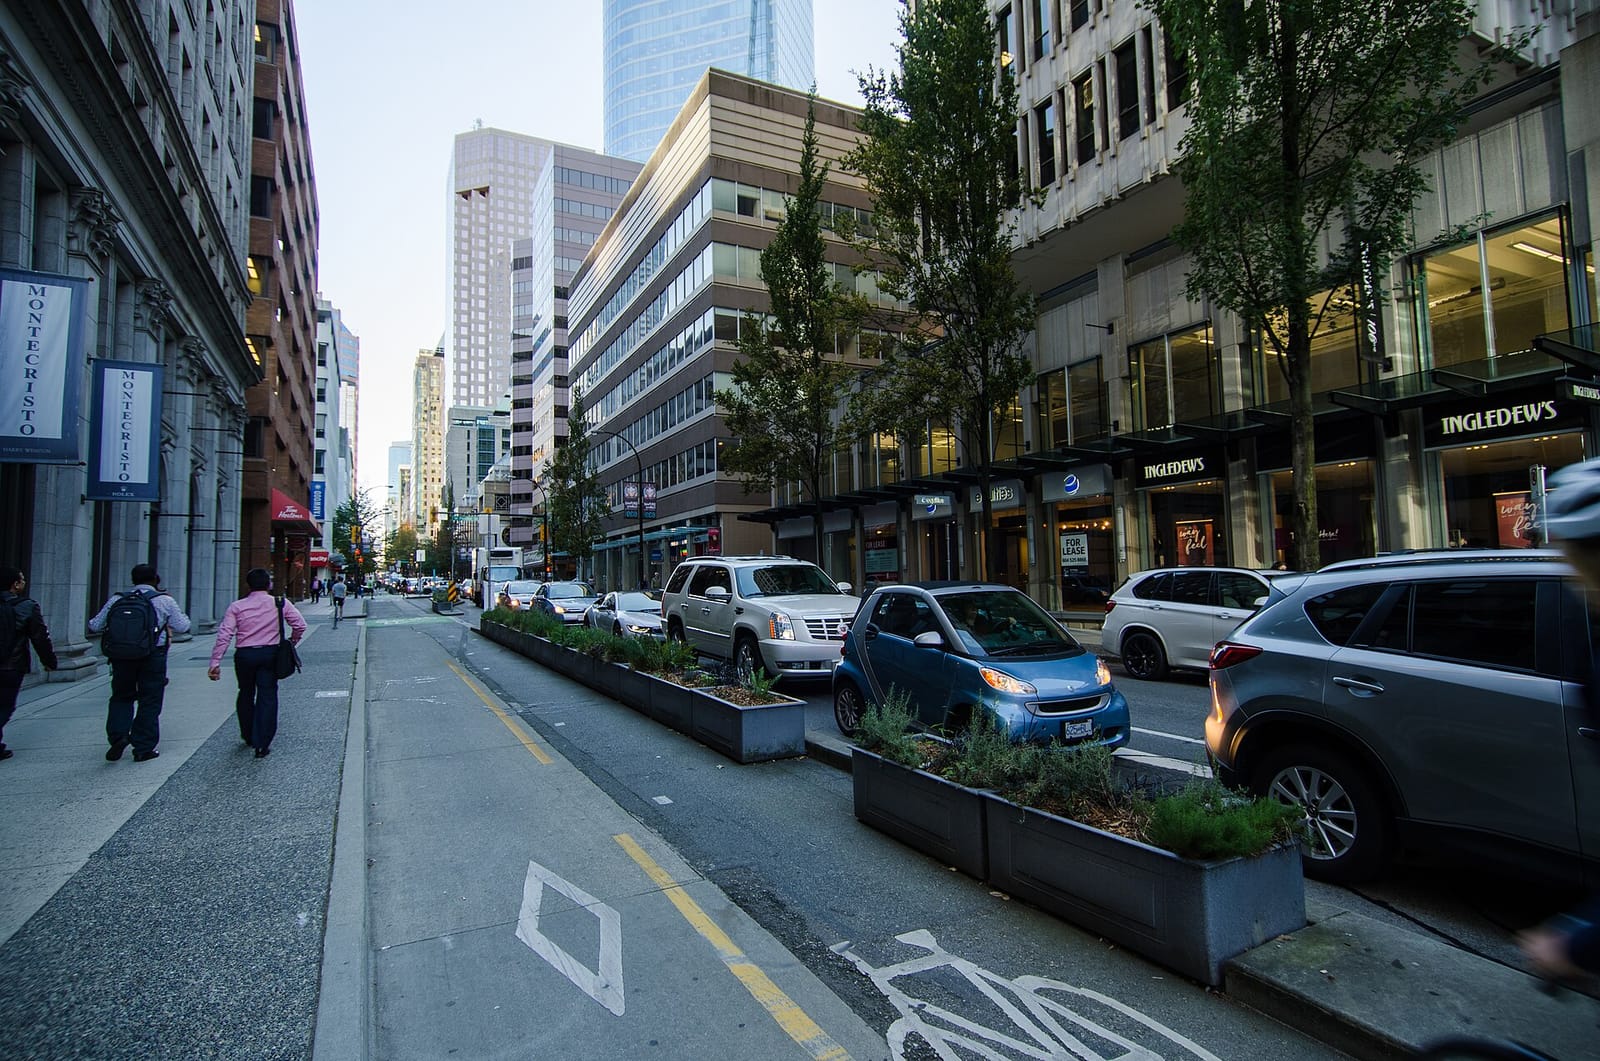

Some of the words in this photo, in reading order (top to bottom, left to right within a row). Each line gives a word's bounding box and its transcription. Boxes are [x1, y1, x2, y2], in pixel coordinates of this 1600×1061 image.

[20, 284, 46, 436] MONTECRISTO
[118, 371, 135, 482] MONTECRISTO
[1441, 400, 1558, 435] INGLEDEW'S
[1144, 457, 1206, 480] INGLEDEW'S
[278, 511, 304, 519] Hortons
[285, 505, 298, 513] Tim
[1512, 515, 1542, 538] fee
[1063, 546, 1086, 555] LEASE
[1065, 538, 1081, 547] FOR
[1185, 535, 1208, 556] feel
